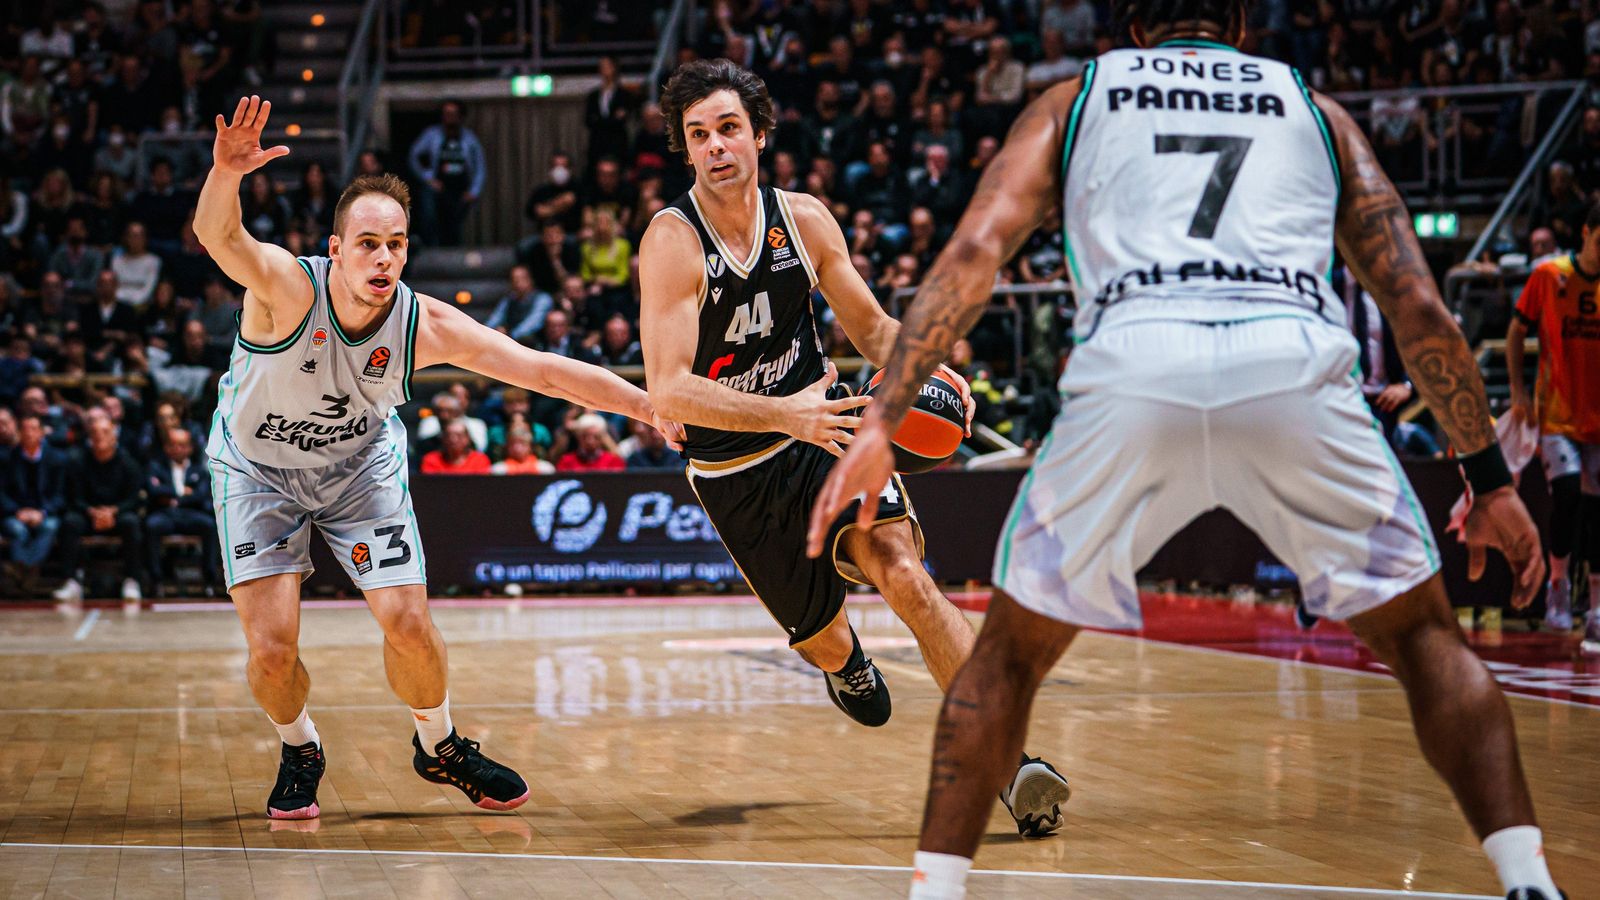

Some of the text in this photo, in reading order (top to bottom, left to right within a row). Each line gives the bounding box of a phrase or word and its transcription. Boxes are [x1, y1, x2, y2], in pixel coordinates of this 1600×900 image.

[1129, 56, 1263, 82] JONES
[1108, 85, 1285, 117] PAMESA
[1154, 133, 1254, 239] 7
[725, 292, 774, 345] 44
[309, 394, 350, 419] 3
[374, 525, 412, 569] 3
[507, 565, 531, 580] un
[534, 563, 584, 582] tappo
[586, 561, 660, 580] Pelliconi
[662, 564, 692, 582] per
[694, 563, 734, 582] ogni
